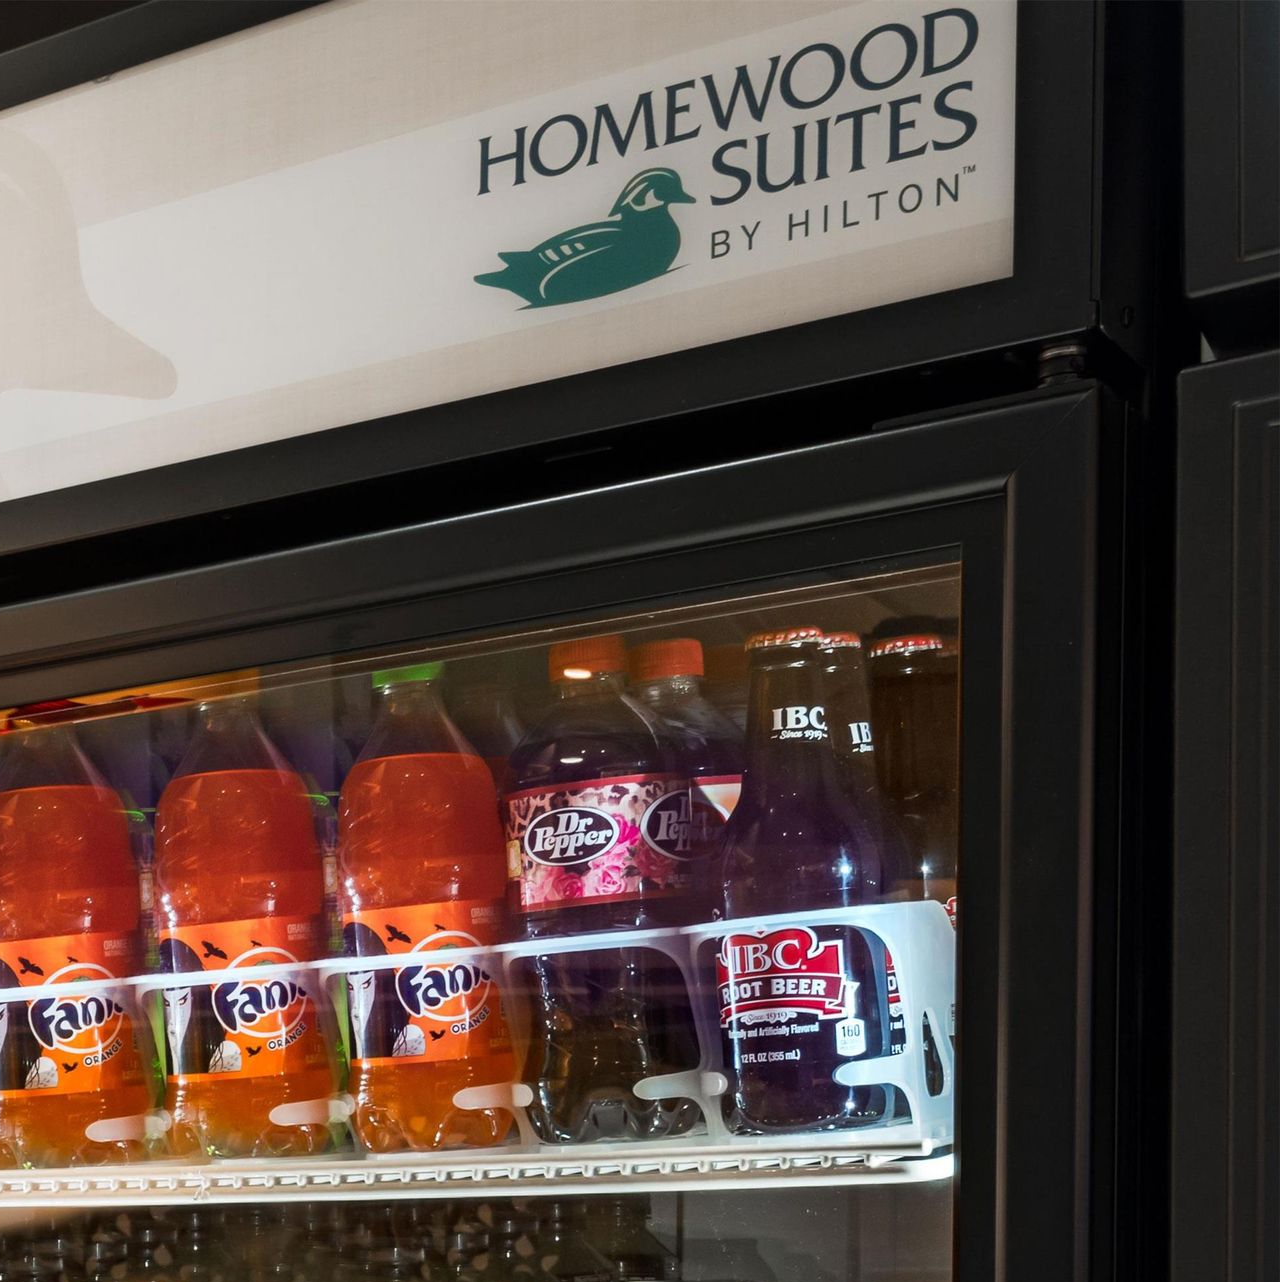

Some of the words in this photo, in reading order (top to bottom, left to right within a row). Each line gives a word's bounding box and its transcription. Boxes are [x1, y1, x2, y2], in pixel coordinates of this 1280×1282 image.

[477, 7, 979, 196] HOMEWOOD
[710, 81, 978, 206] SUITES
[711, 221, 762, 259] BY
[771, 705, 827, 731] IBC
[555, 811, 592, 836] Dr
[534, 826, 614, 860] Pepper
[730, 938, 802, 974] IBC
[722, 980, 762, 1005] ROOT
[770, 977, 827, 997] BEER
[449, 1005, 490, 1035] ORANGE
[748, 1027, 757, 1039] and
[757, 1024, 789, 1038] Artificially
[790, 1021, 819, 1035] Flavored
[266, 1022, 308, 1051] ORANGE
[83, 1039, 124, 1067] ORANGE
